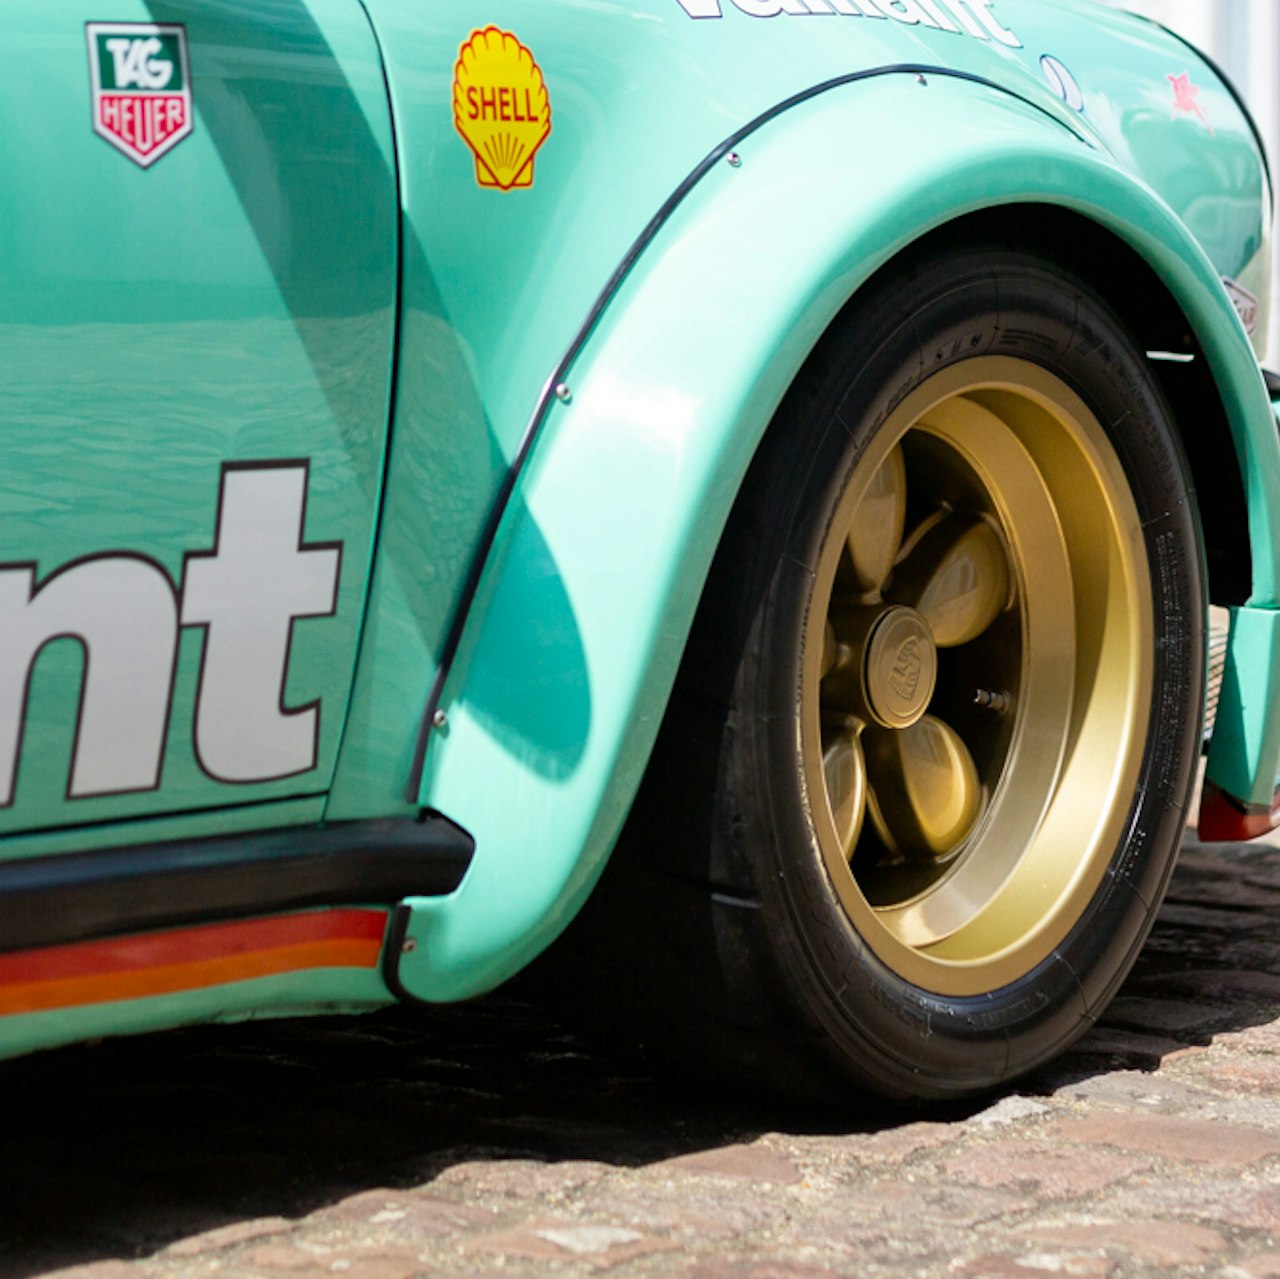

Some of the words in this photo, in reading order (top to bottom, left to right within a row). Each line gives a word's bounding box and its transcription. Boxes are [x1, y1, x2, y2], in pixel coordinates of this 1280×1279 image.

[105, 37, 174, 90] TAG
[102, 97, 184, 151] HEUER
[467, 85, 539, 123] SHELL
